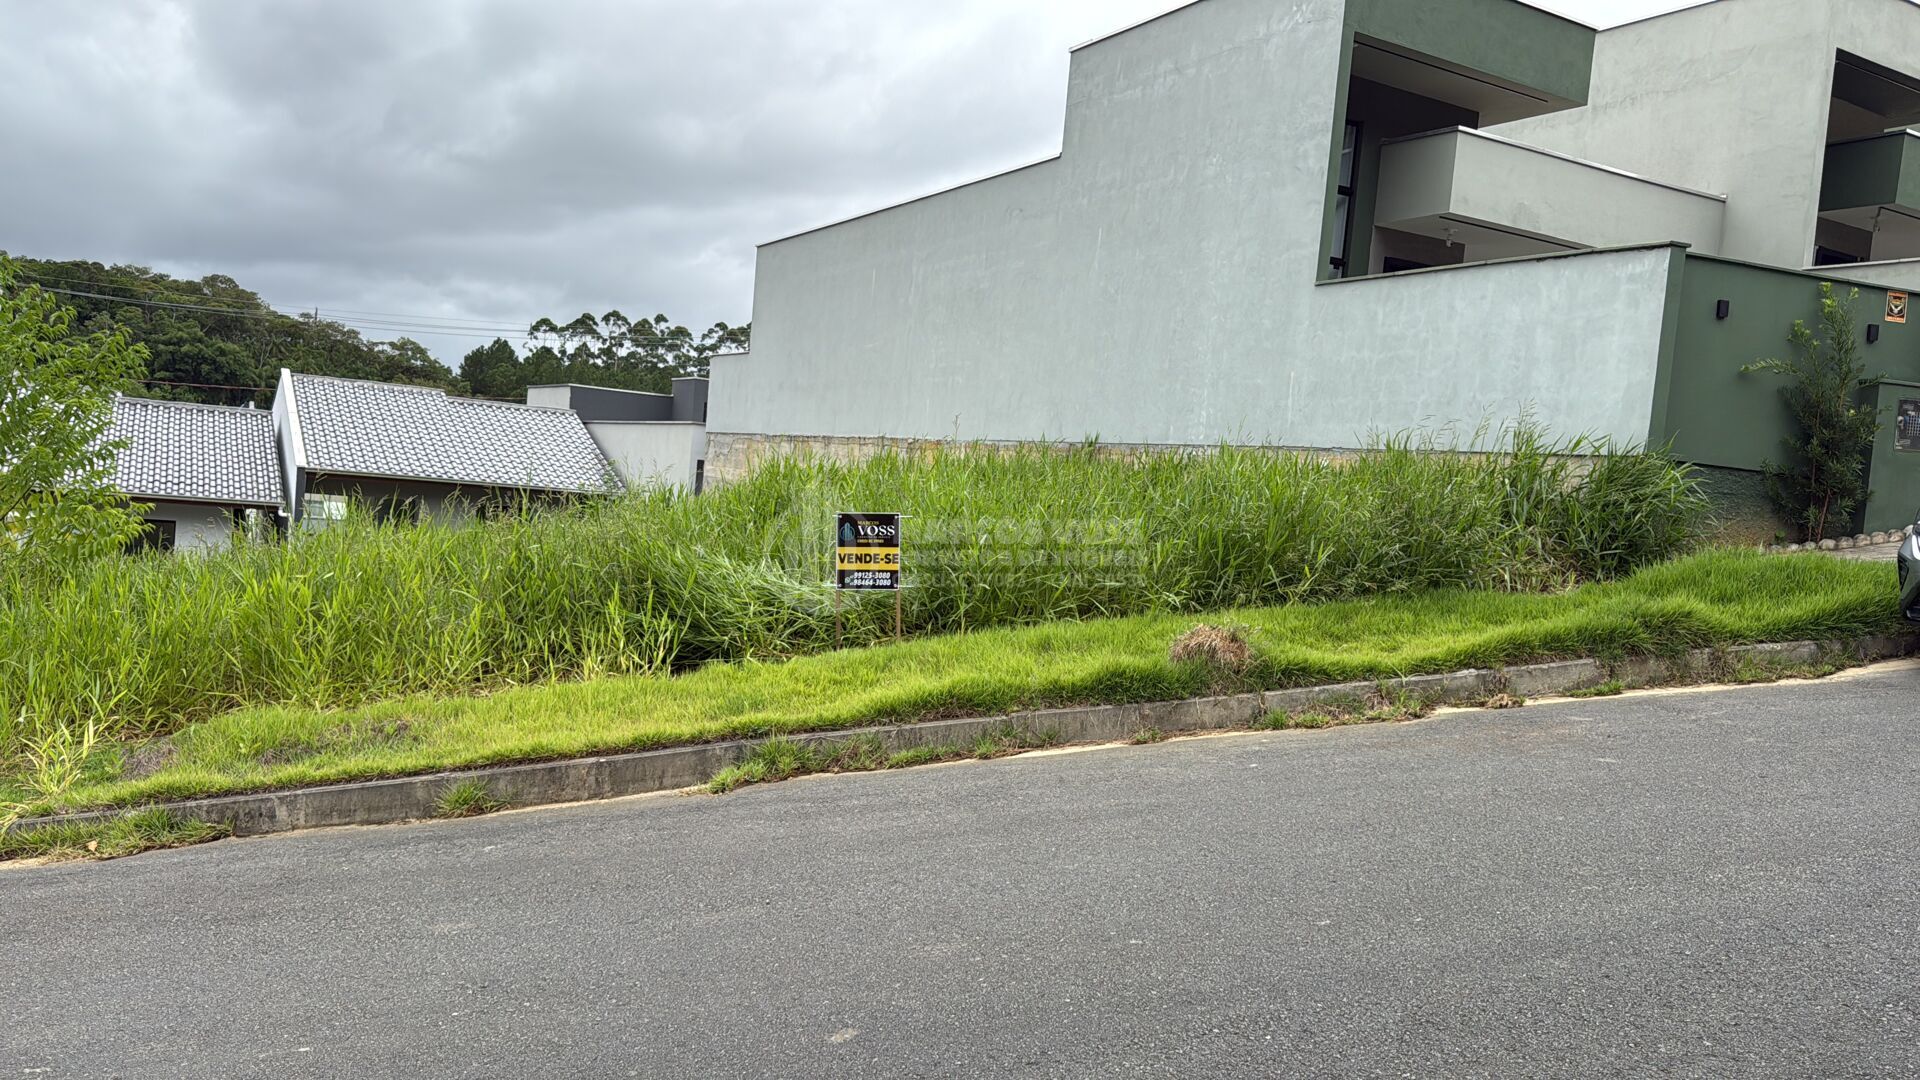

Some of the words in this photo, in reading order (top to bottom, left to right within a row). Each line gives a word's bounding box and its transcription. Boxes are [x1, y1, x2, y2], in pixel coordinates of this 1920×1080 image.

[858, 525, 895, 536] VOSS
[838, 553, 899, 565] VENDE-SE
[854, 571, 891, 579] 99125-3080
